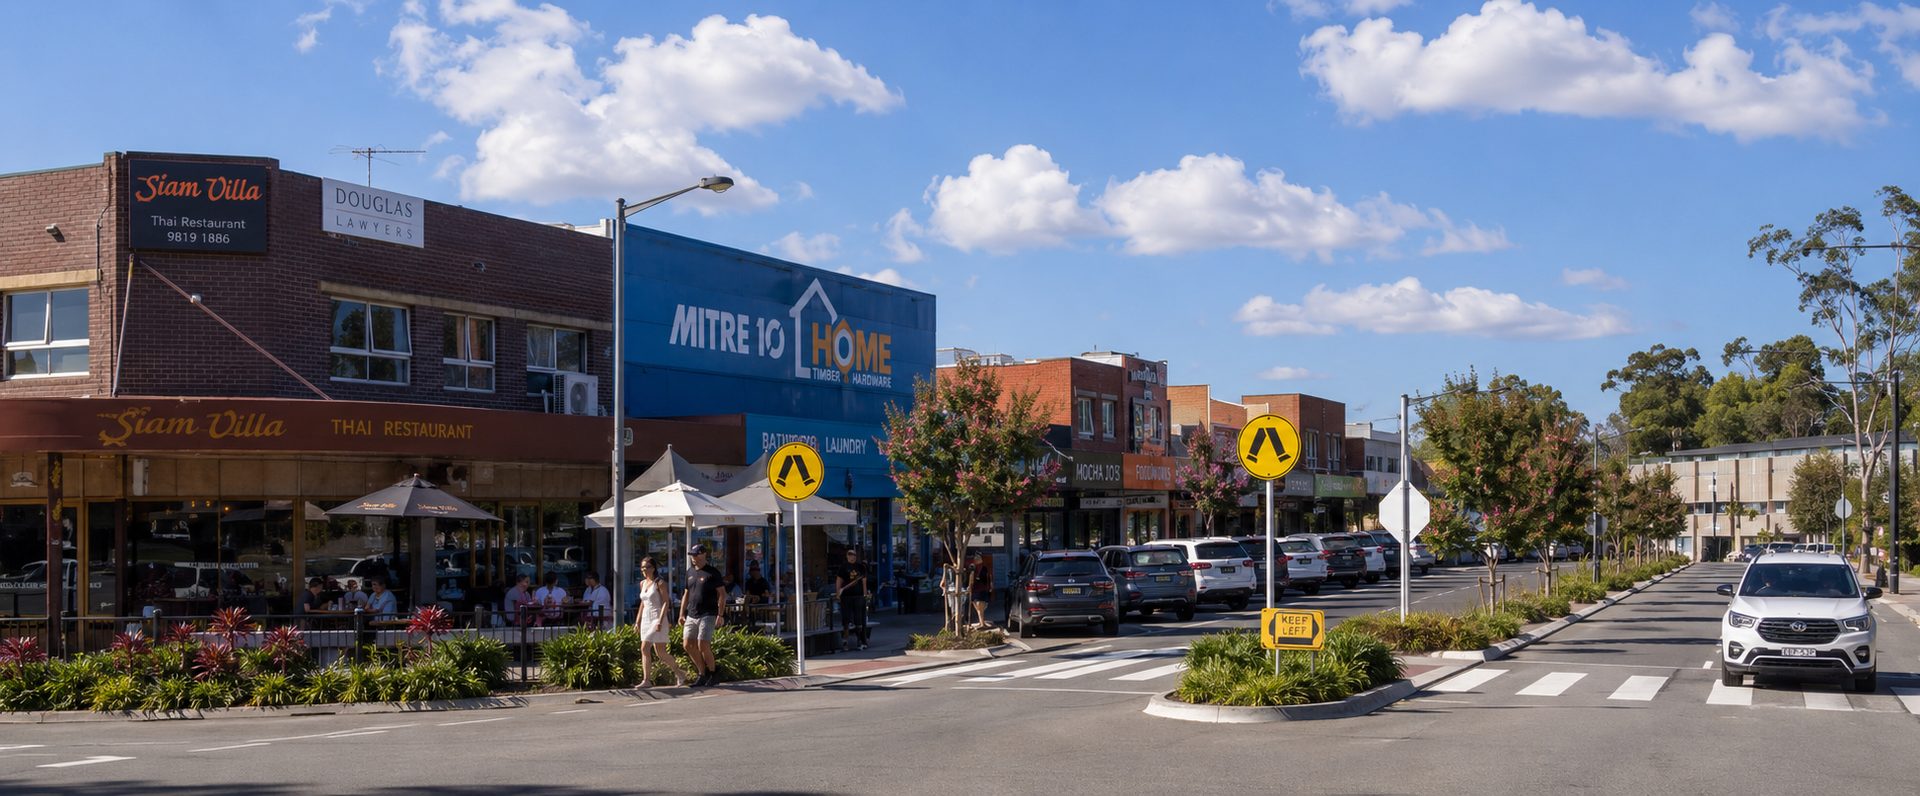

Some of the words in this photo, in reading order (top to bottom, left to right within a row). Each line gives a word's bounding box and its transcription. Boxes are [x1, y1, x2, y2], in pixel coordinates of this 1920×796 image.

[135, 173, 202, 202] Siam
[206, 175, 263, 202] Villa
[336, 187, 413, 218] DOUGLAS
[151, 215, 177, 228] Thai
[181, 216, 246, 230] Restaurant
[336, 215, 413, 240] LAWYERS
[167, 231, 197, 243] 9819
[202, 232, 230, 244] 1886
[669, 303, 750, 355] MITRE
[756, 317, 785, 360] 10
[811, 319, 892, 375] HOME
[812, 367, 841, 383] TIMBER
[852, 372, 892, 388] HARDWARE
[97, 406, 200, 447] Siam
[206, 409, 287, 438] Villa
[331, 419, 372, 436] THAI
[384, 420, 474, 440] RESTAURANT
[825, 436, 867, 455] LAUNDRY
[1076, 463, 1104, 481] MOCHA
